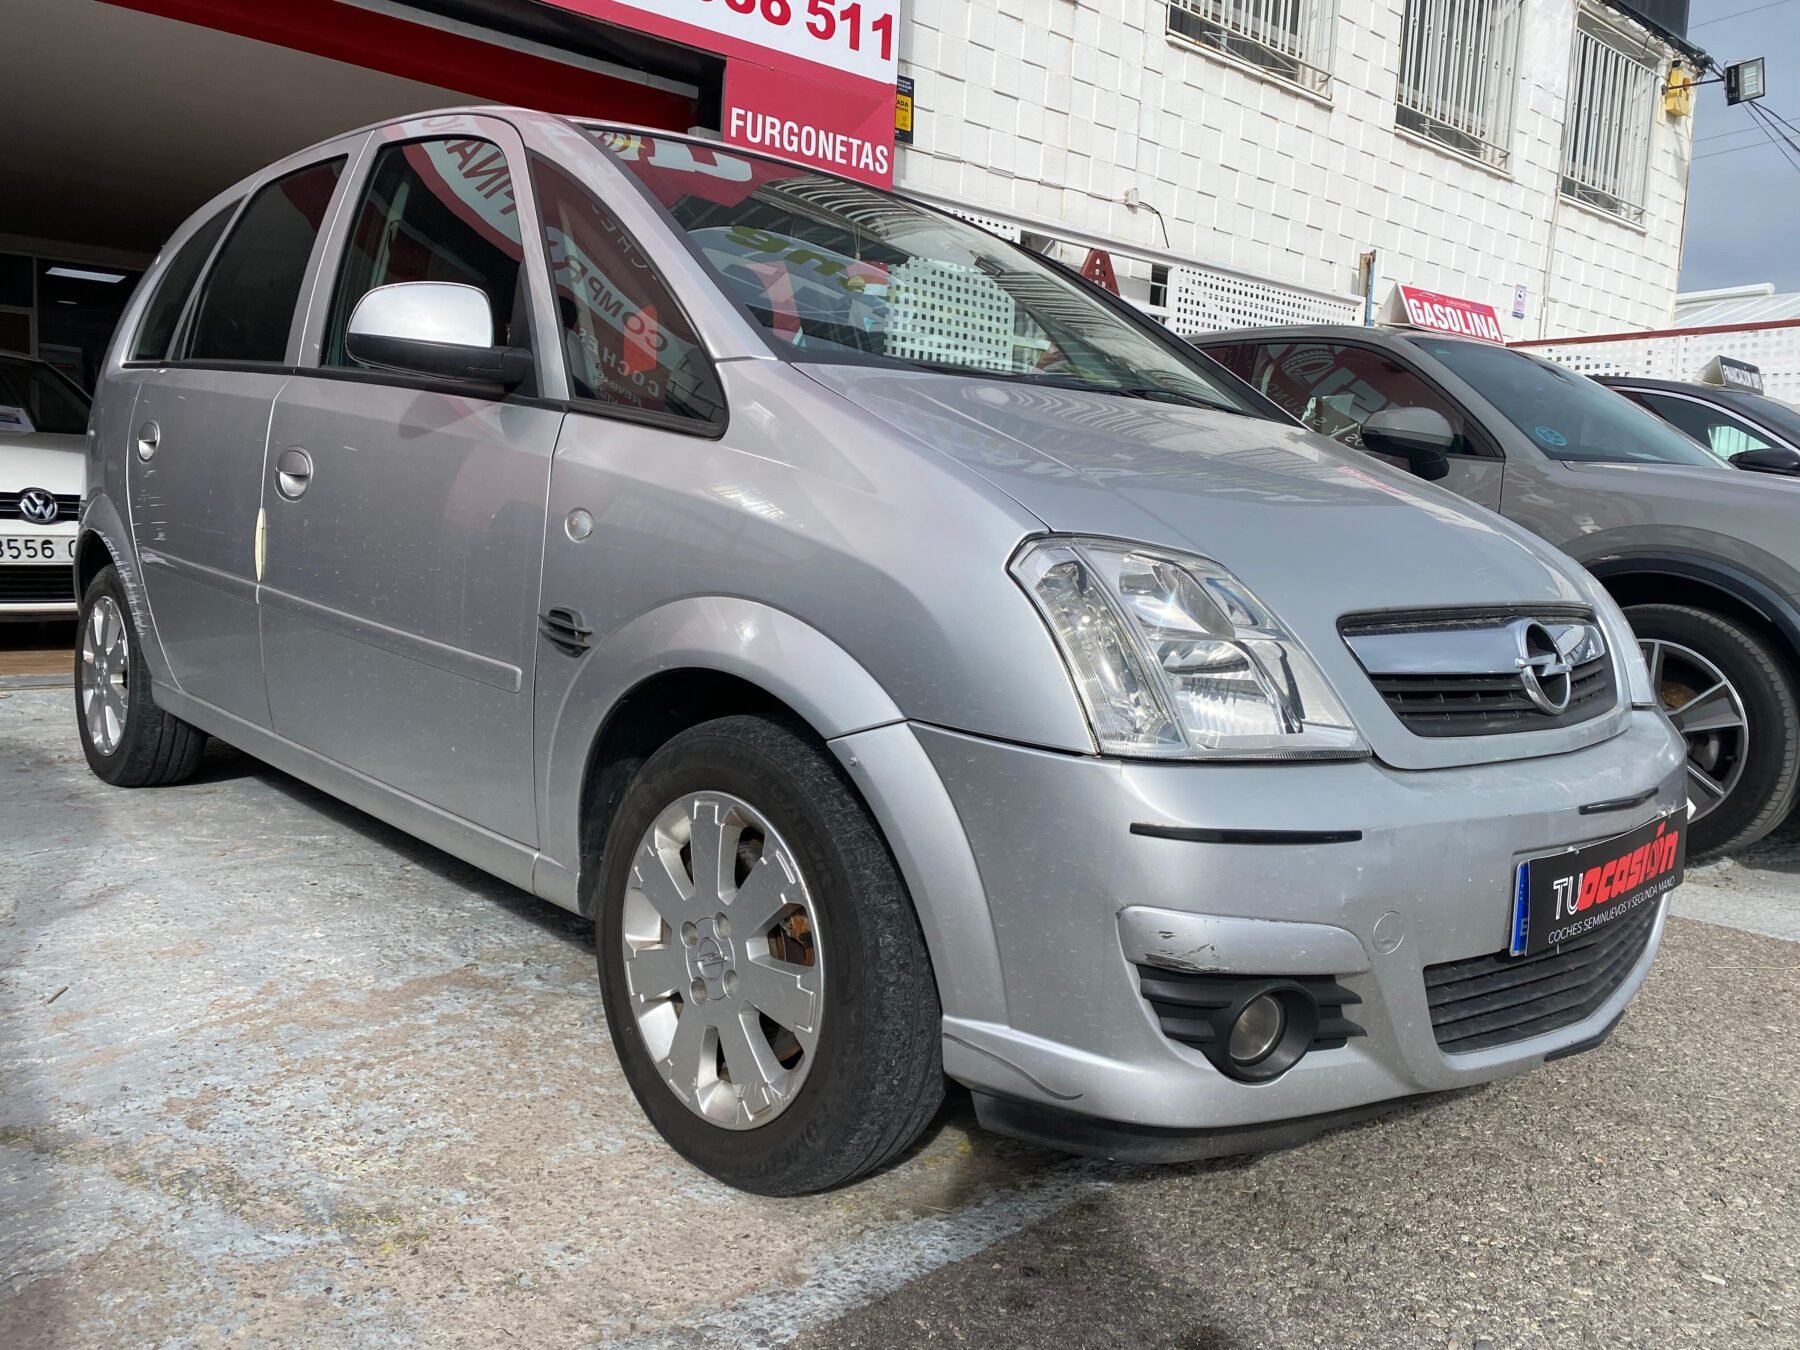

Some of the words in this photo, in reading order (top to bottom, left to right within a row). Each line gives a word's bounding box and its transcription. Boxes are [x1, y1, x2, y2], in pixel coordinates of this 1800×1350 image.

[806, 0, 893, 61] 511
[730, 107, 889, 174] FURGONETAS
[1408, 299, 1501, 341] GASOLINA
[0, 538, 55, 560] 556
[1548, 921, 1583, 944] COCHES
[1583, 901, 1628, 931] SEMINUEVOS
[1631, 886, 1658, 908] SEGUNDA
[1658, 875, 1675, 894] MANO
